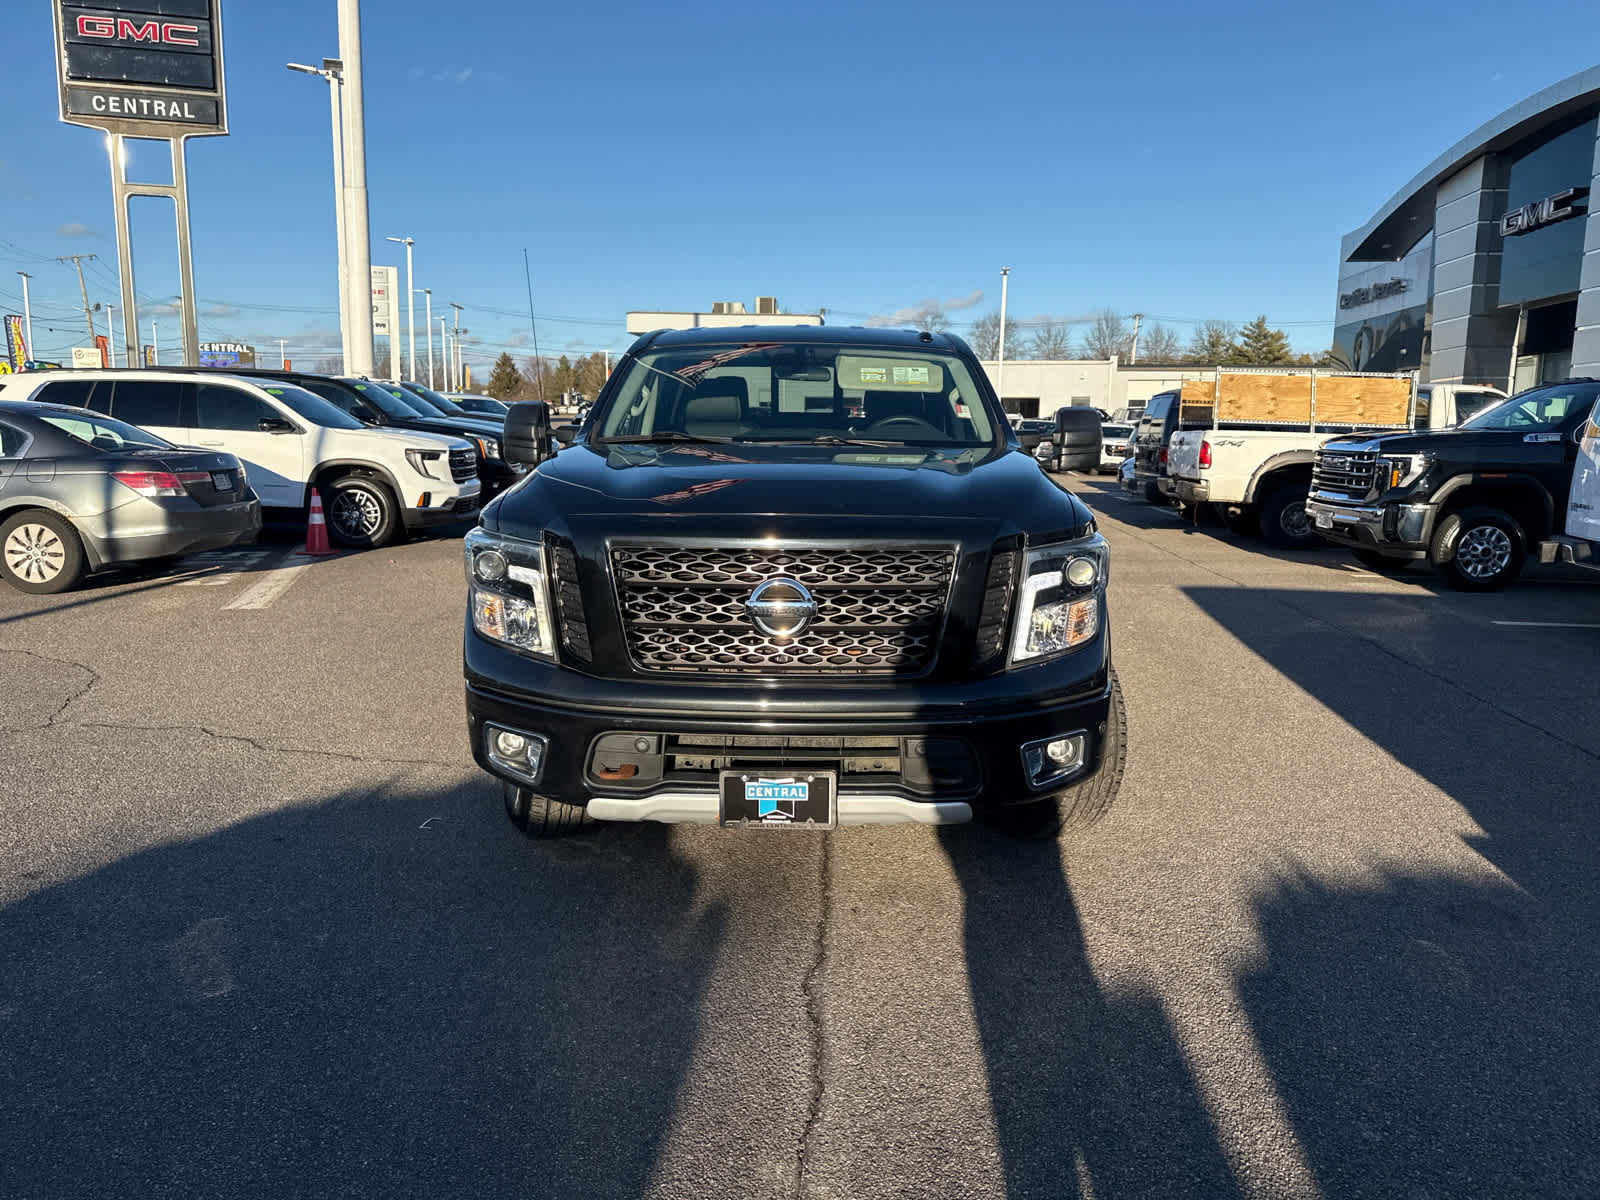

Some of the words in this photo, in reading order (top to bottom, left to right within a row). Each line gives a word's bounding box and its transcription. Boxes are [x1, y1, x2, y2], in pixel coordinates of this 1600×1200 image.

[76, 15, 199, 47] GMC
[91, 95, 196, 119] CENTRAL
[1500, 188, 1574, 237] GMC
[199, 343, 250, 353] CENTRAL
[747, 786, 806, 798] CENTRAL
